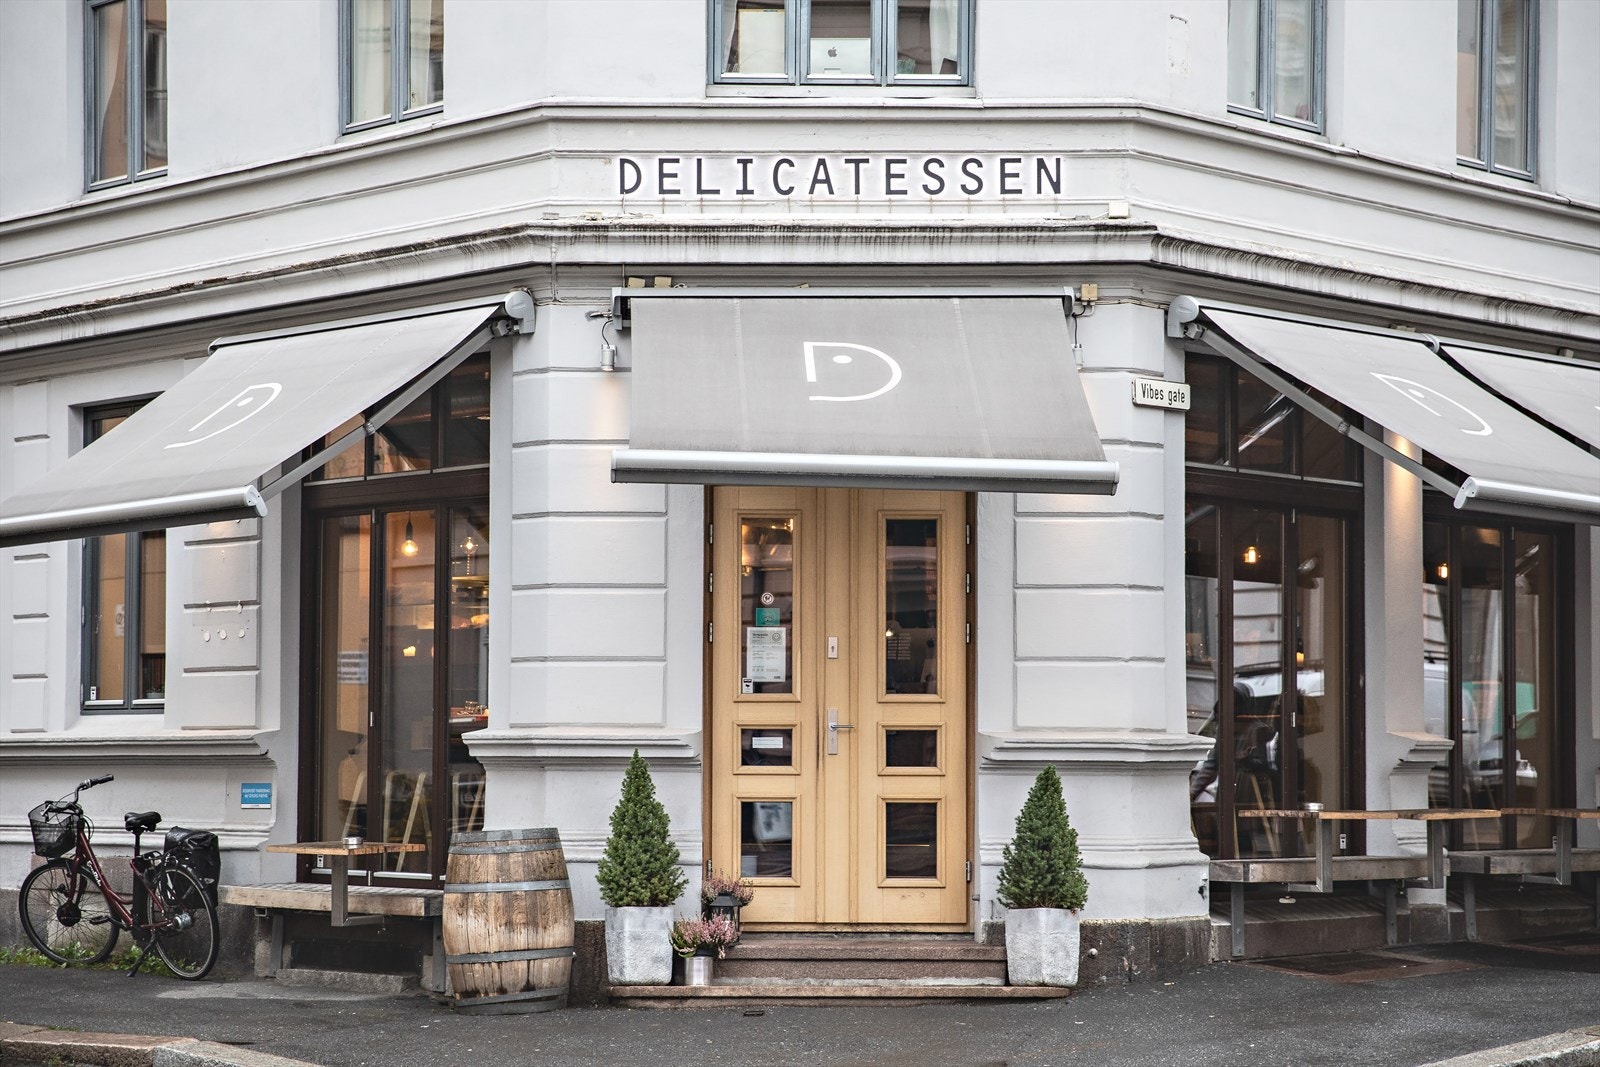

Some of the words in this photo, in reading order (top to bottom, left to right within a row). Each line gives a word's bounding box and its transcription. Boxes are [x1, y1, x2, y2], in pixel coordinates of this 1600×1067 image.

[619, 157, 1062, 195] DELICATESSEN
[1141, 383, 1164, 400] Vibes
[1167, 389, 1186, 406] gate
